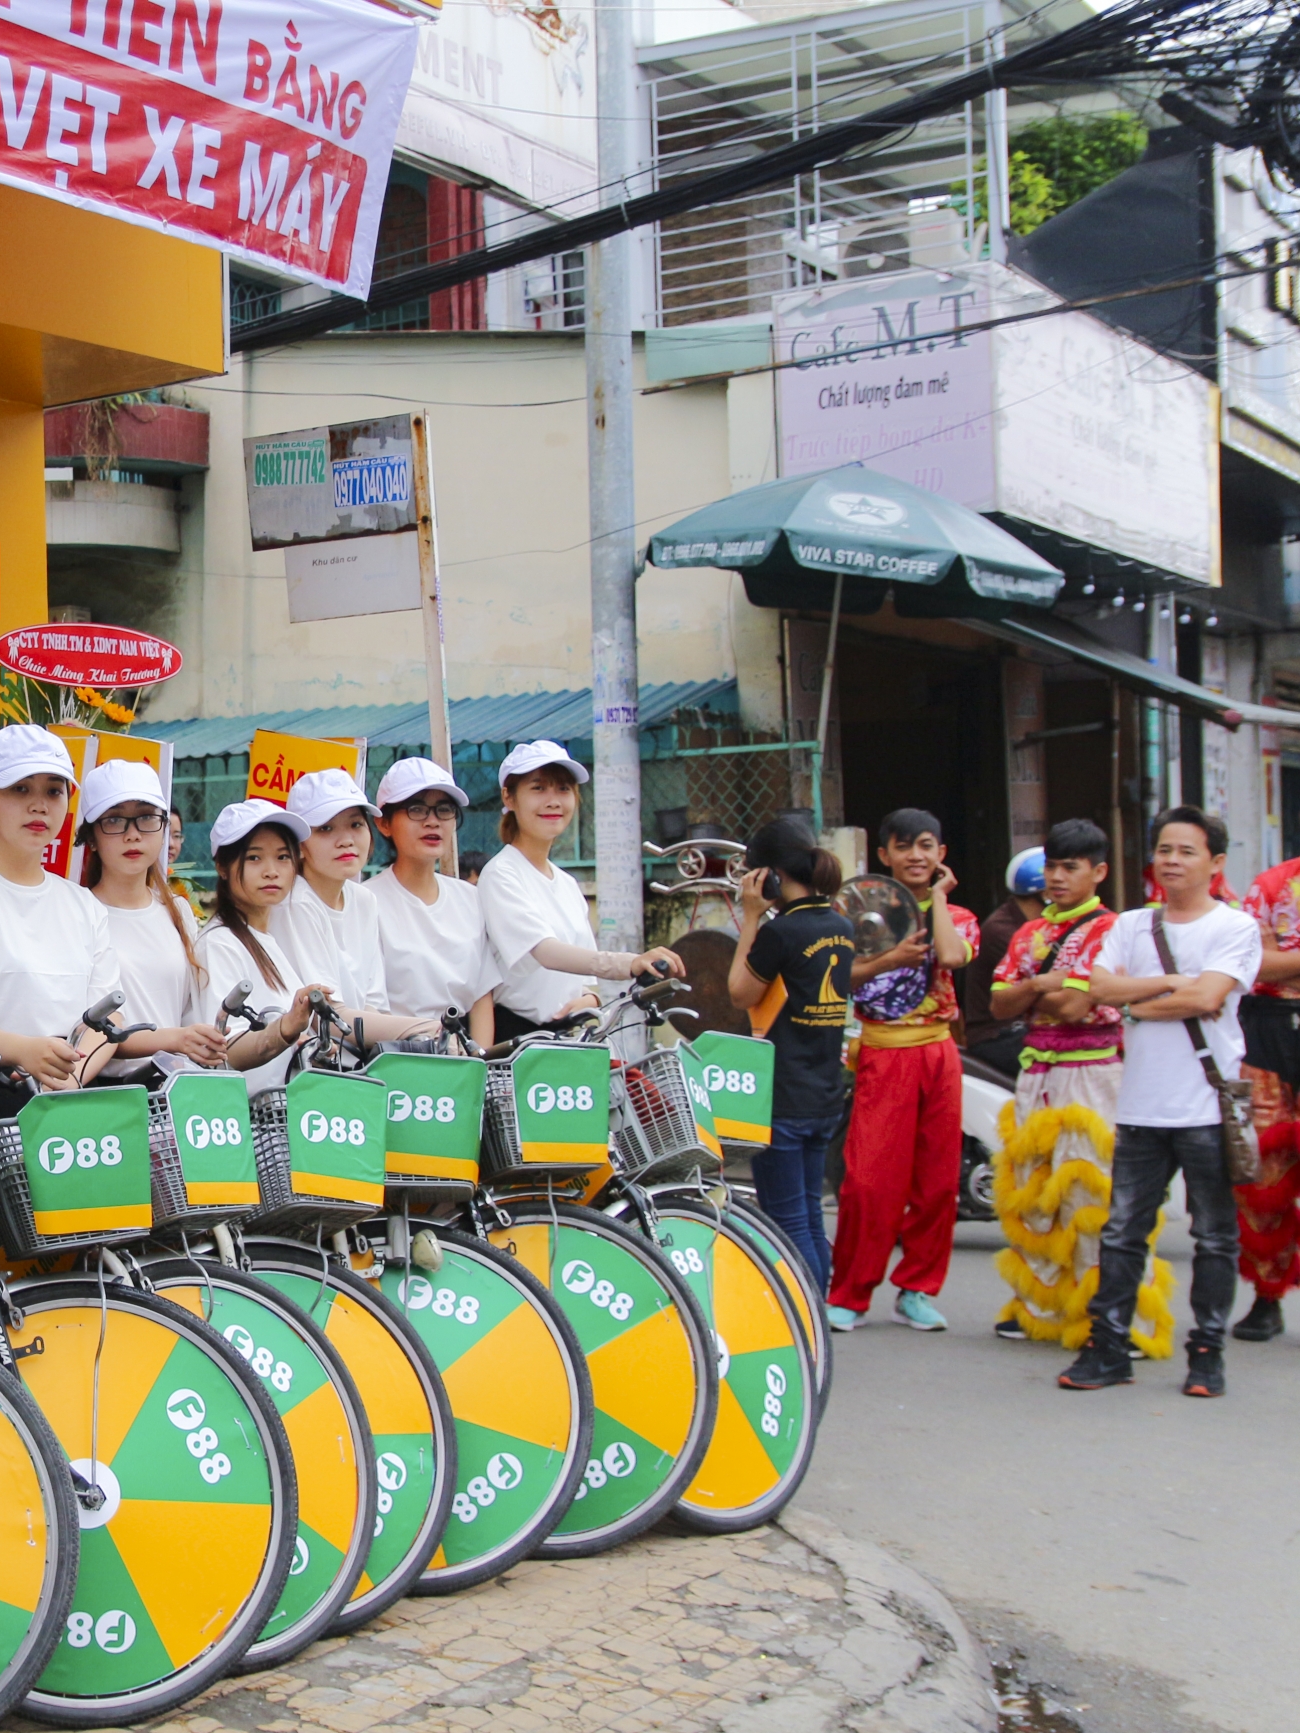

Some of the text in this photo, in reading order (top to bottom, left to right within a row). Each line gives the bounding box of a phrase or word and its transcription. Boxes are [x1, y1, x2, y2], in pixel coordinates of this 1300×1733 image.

[243, 19, 367, 140] BẰNG
[137, 105, 222, 210] XE
[238, 140, 351, 252] MÁY
[818, 371, 949, 410] Chất lượng đam mê
[312, 558, 328, 567] Khu
[798, 545, 939, 577] VIVA STAR COFFEE
[19, 632, 40, 649] CTY
[119, 640, 138, 656] NAM
[139, 639, 161, 660] VIỆT
[18, 655, 162, 683] Chúc Mừng Khai Trương
[526, 1082, 594, 1114] F88
[702, 1064, 757, 1095] F88
[387, 1089, 456, 1123] F88
[185, 1113, 242, 1149] F88
[300, 1109, 366, 1147] F88
[38, 1134, 123, 1175] F88
[670, 1247, 704, 1276] 88
[398, 1275, 481, 1326] F88
[561, 1259, 635, 1321] F88
[222, 1324, 294, 1393] F88
[760, 1363, 787, 1437] F88
[166, 1388, 232, 1485] F88
[452, 1452, 523, 1524] F88
